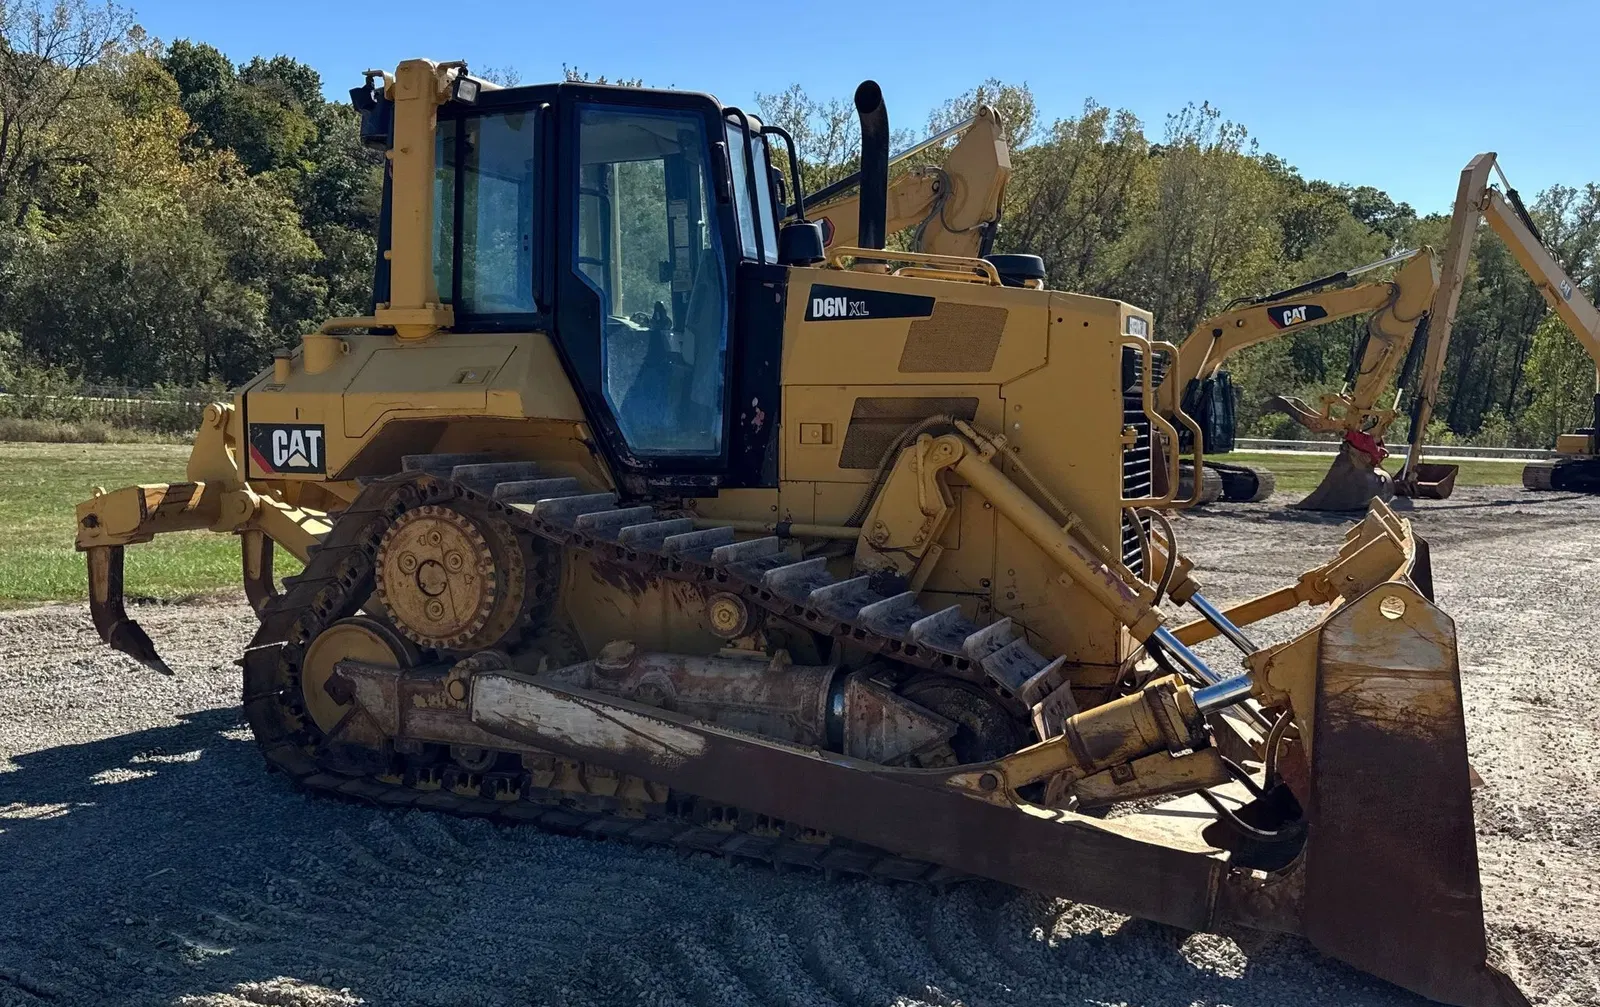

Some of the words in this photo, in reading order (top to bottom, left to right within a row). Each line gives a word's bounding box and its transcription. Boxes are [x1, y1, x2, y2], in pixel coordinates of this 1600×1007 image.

[1560, 280, 1571, 296] CAT
[812, 297, 847, 318] D6N
[849, 301, 869, 316] XL
[1283, 306, 1307, 326] CAT
[272, 429, 322, 468] CAT
